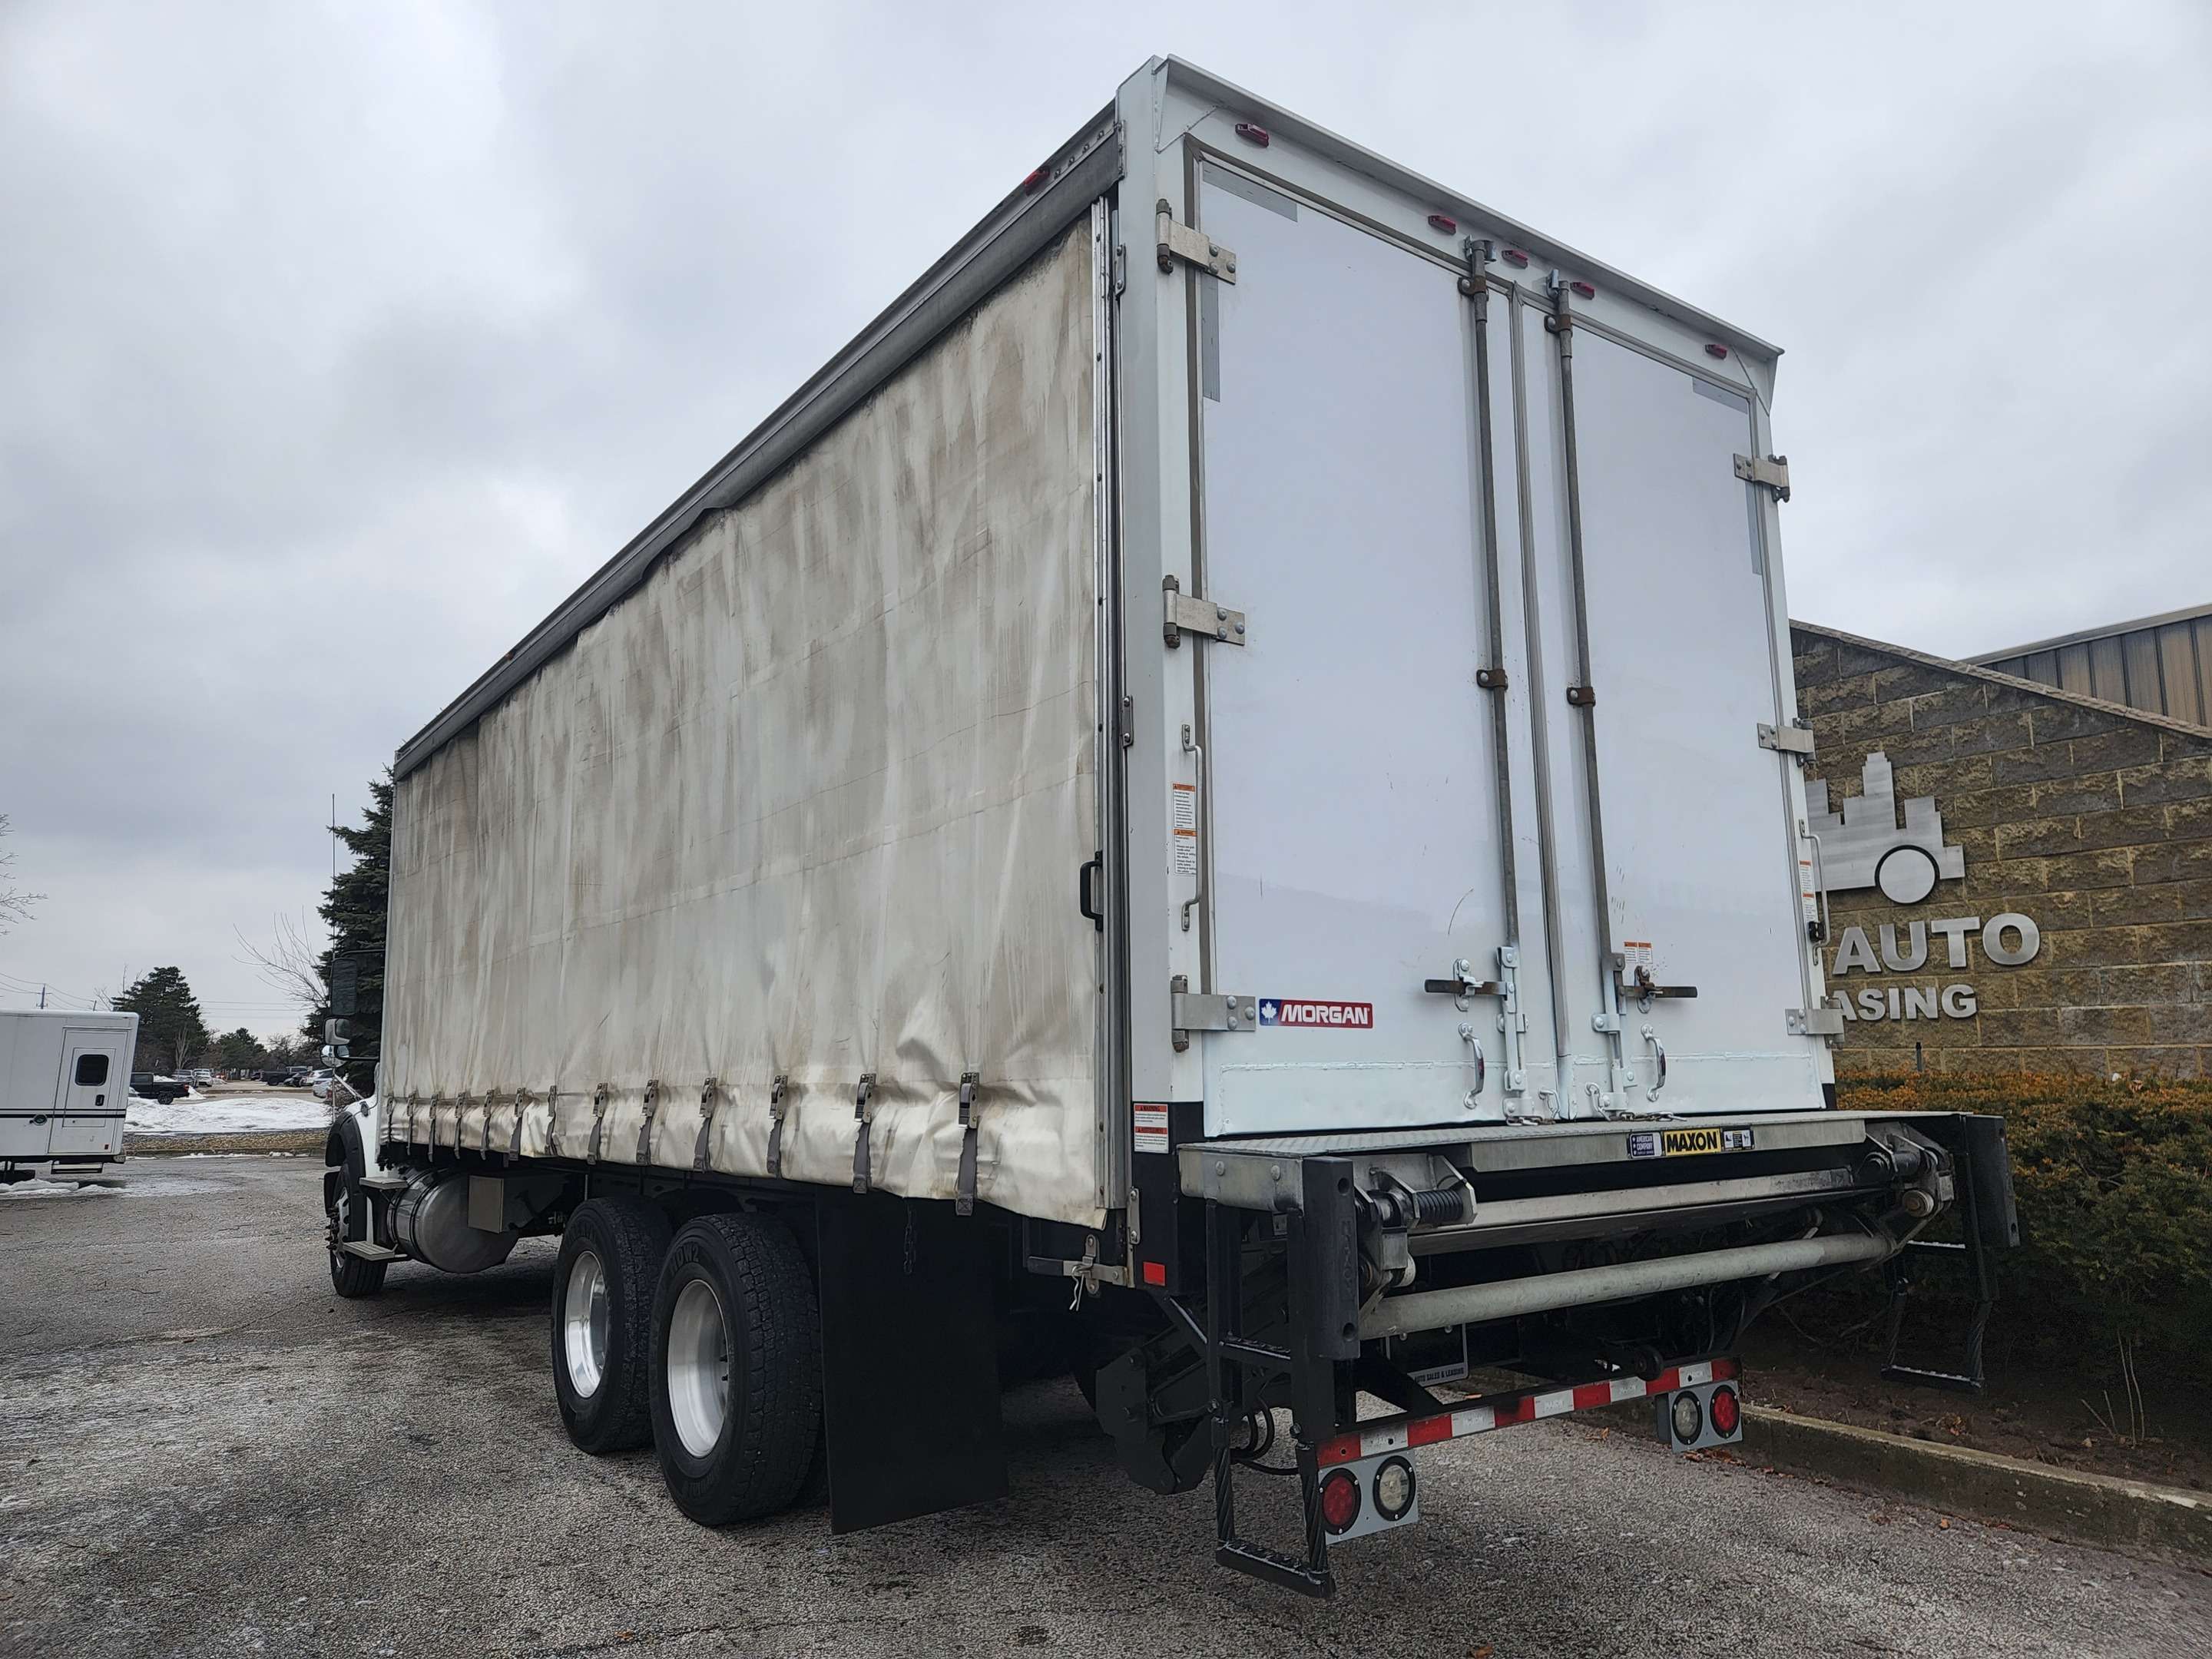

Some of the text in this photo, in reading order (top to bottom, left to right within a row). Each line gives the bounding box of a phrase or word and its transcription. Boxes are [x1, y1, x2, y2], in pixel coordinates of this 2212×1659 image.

[1832, 912, 2040, 975] AUTO
[1832, 984, 1977, 1021] ASING
[1280, 1004, 1369, 1025] MORGAN
[1636, 1142, 1654, 1151] COMPANY
[1667, 1131, 1717, 1153] MAXON
[1426, 1371, 1440, 1381] SALES
[1445, 1367, 1464, 1376] LEASING
